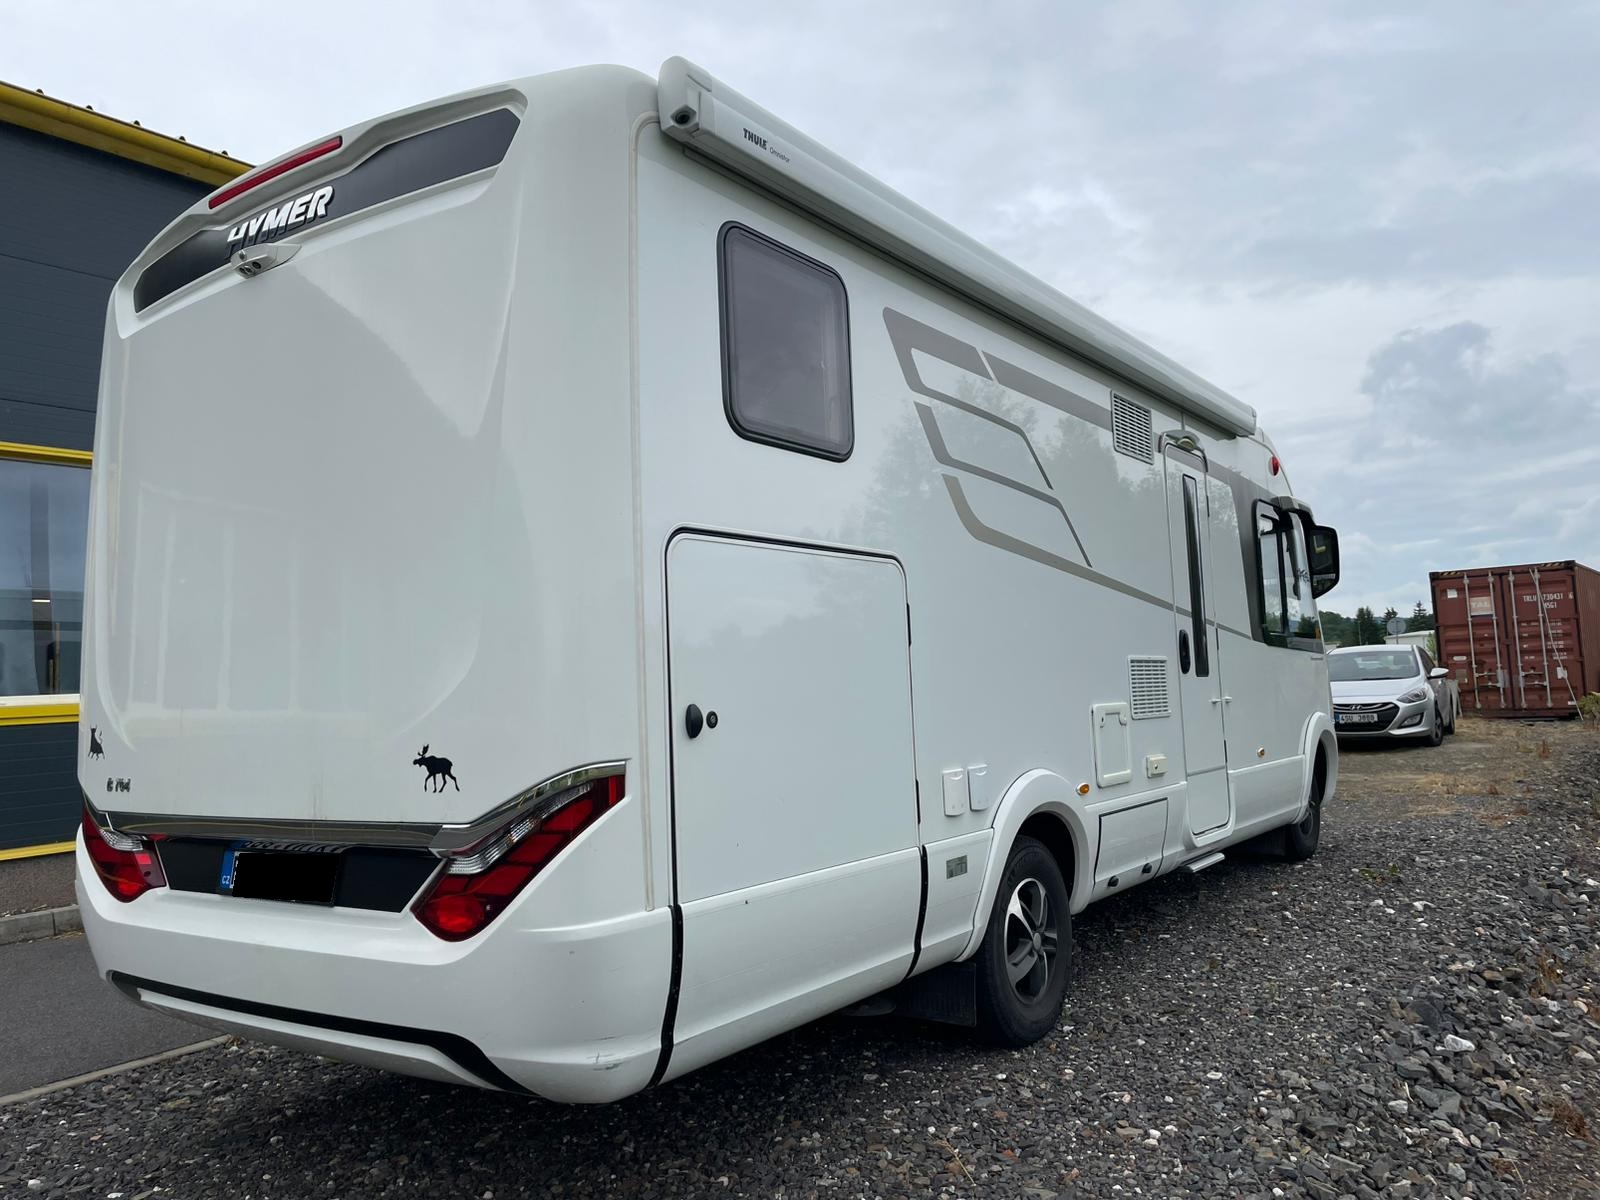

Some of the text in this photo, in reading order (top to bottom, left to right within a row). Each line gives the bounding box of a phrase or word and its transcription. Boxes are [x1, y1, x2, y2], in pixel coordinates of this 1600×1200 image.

[743, 127, 767, 150] THULE
[225, 185, 334, 259] HYMER
[222, 875, 231, 885] CZ
